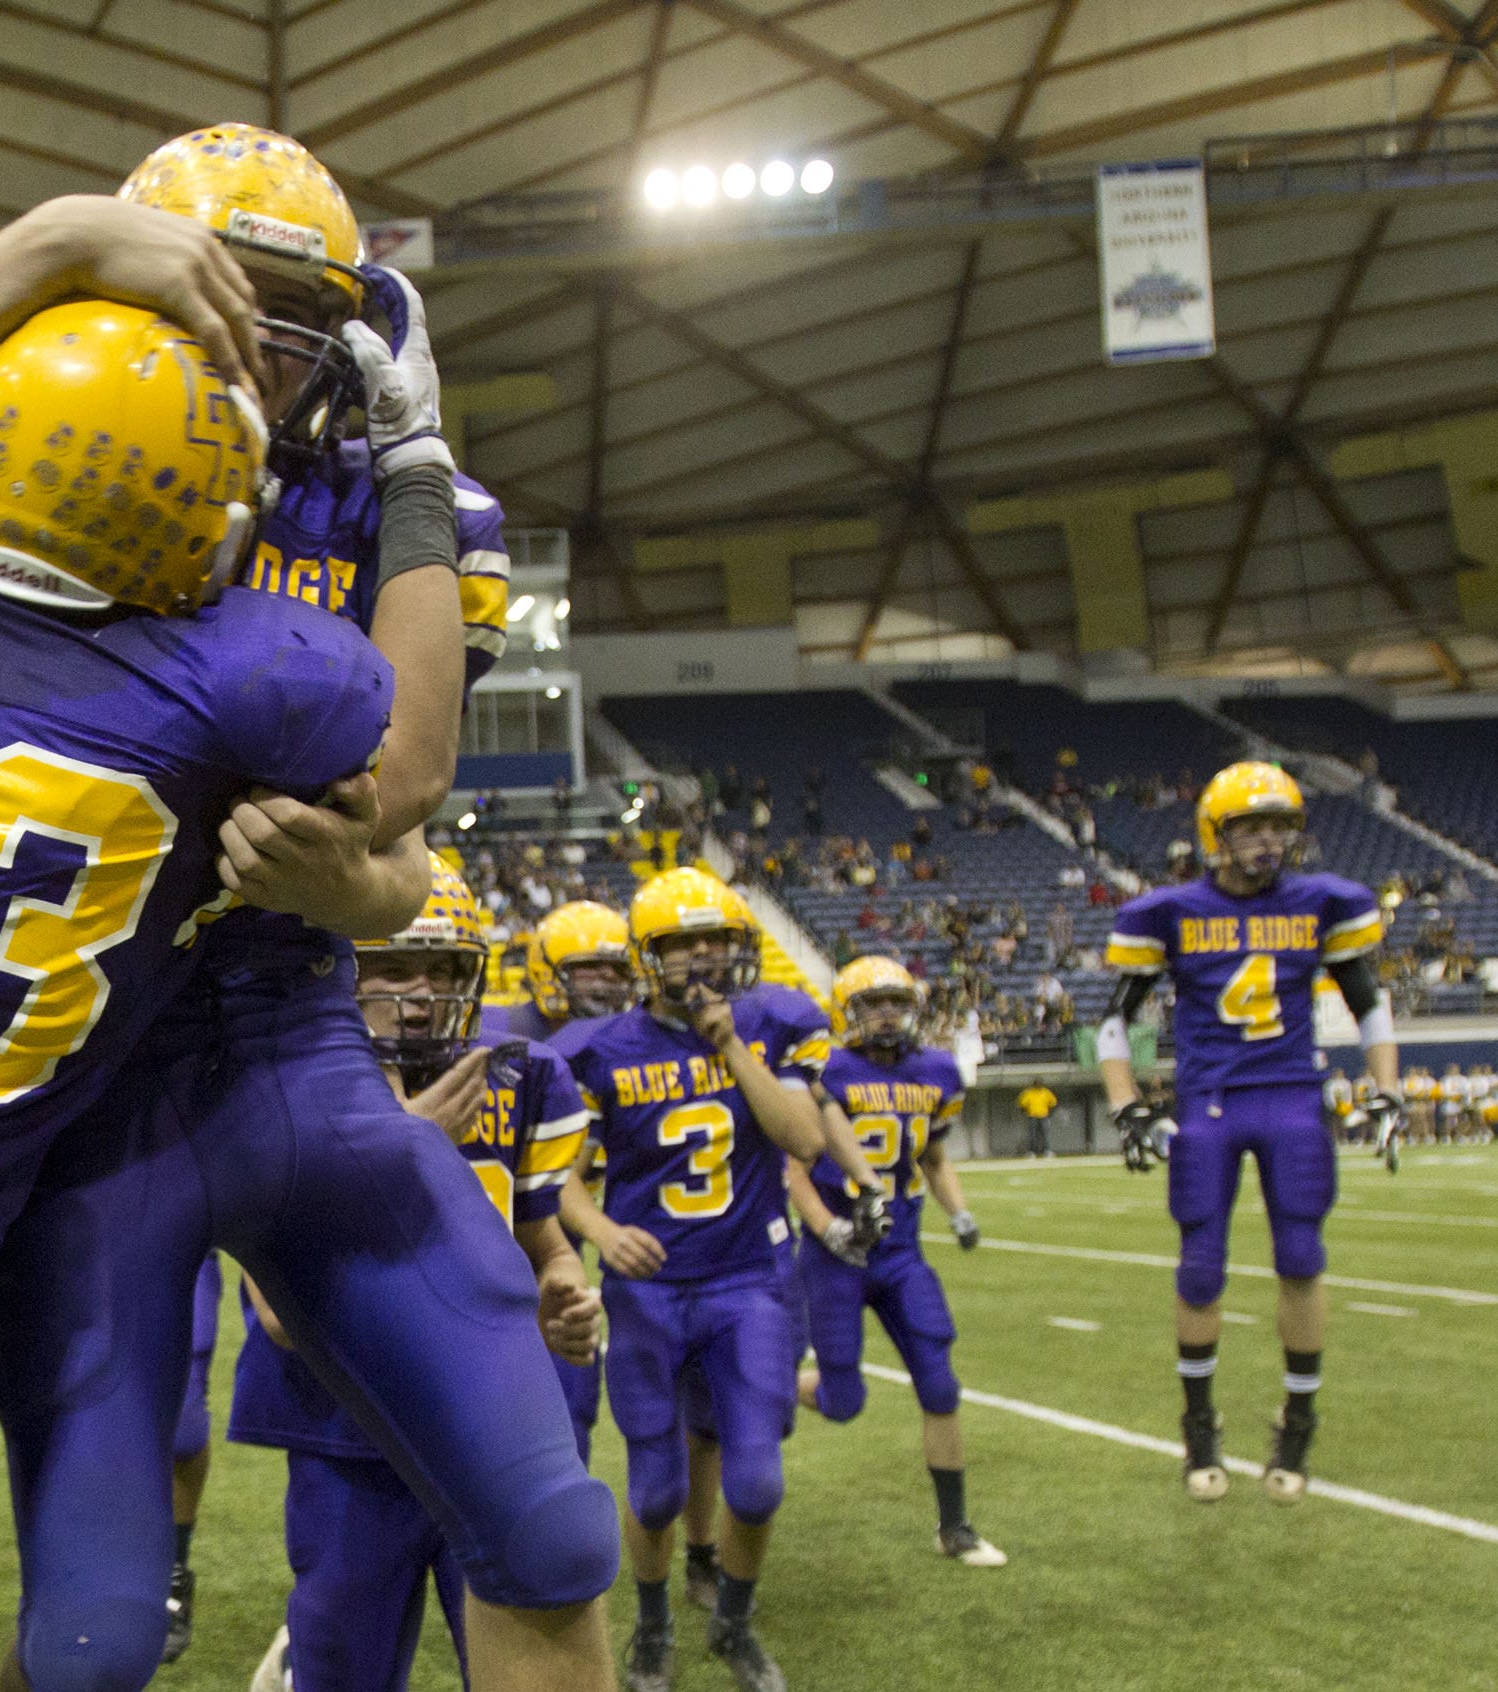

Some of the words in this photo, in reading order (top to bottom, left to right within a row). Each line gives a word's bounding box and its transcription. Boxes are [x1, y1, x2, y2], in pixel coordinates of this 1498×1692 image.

[250, 220, 307, 247] Riddell
[250, 540, 358, 613] DGE
[1180, 917, 1240, 954] BLUE
[1246, 914, 1318, 951] RIDGE
[1217, 953, 1285, 1042] 4
[612, 1060, 685, 1107] BLUE
[658, 1100, 735, 1219] 3
[843, 1113, 930, 1201] 21
